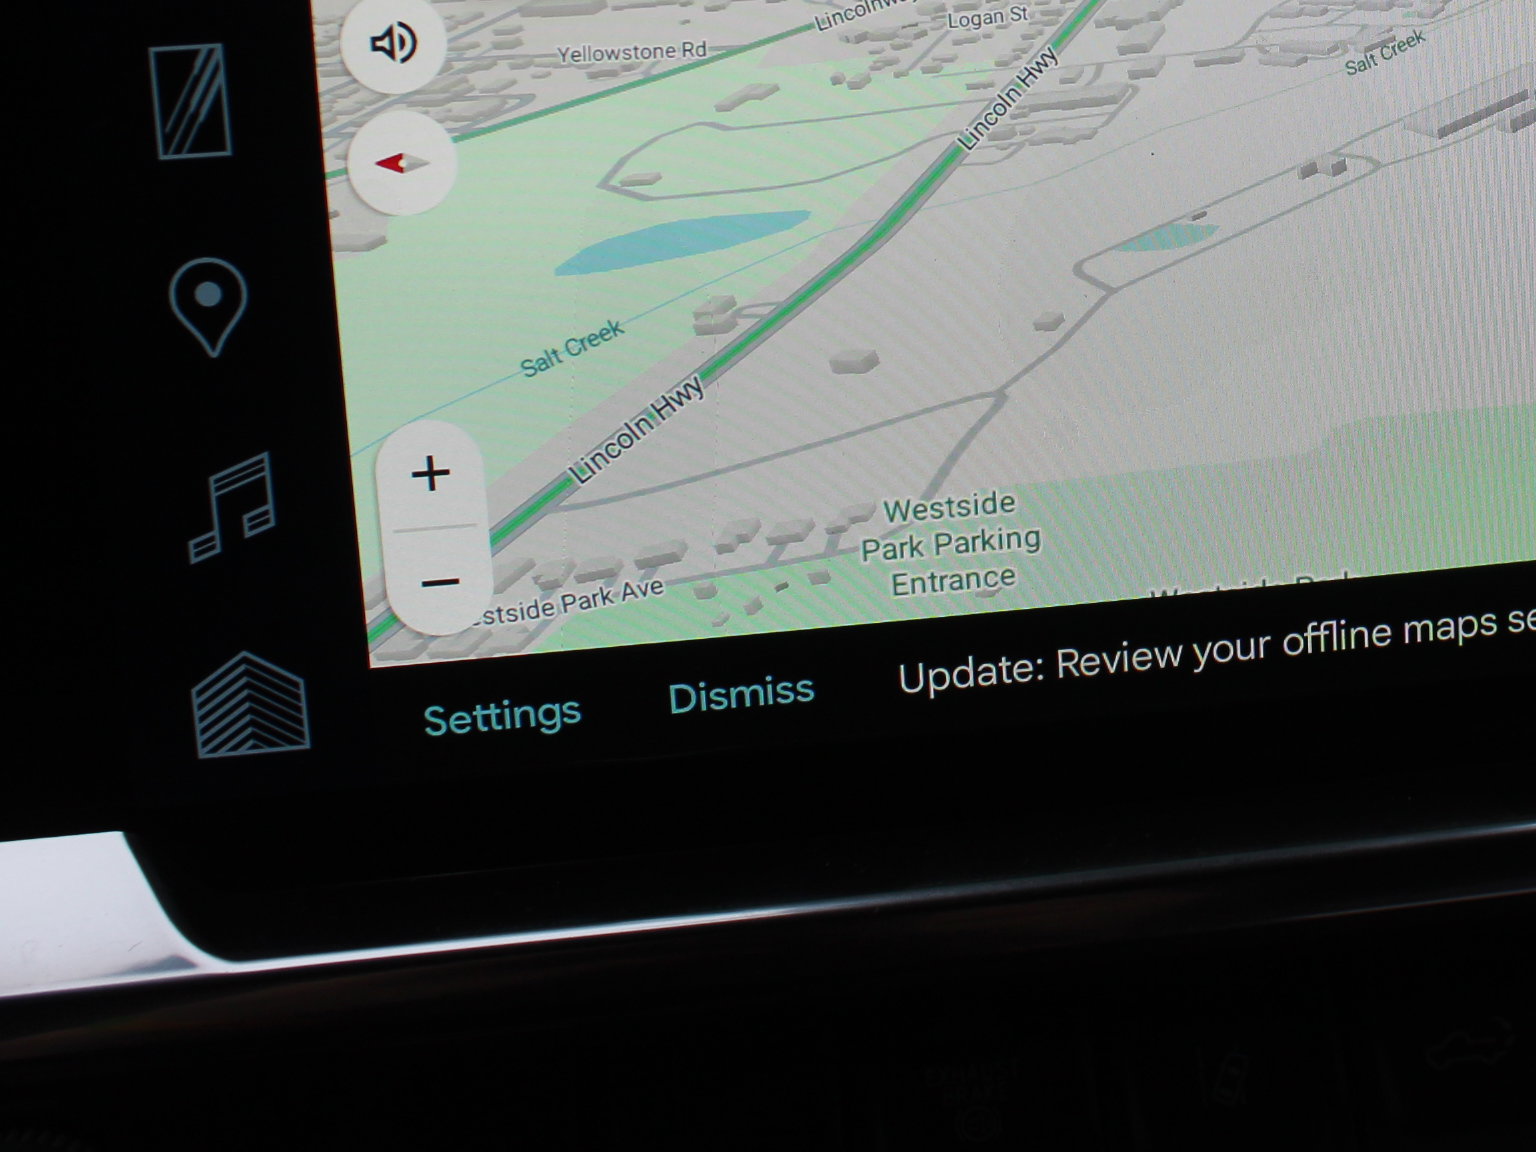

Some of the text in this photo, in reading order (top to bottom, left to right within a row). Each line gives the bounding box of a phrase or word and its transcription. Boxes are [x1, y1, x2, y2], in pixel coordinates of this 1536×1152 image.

[948, 6, 1029, 31] Logan St
[557, 41, 707, 64] Yellowstone Rd
[1345, 29, 1427, 77] Salt Creek
[957, 47, 1060, 151] Lincoln Hwy
[520, 319, 626, 378] Salt Creek
[569, 375, 705, 485] Lincoln Hwy
[883, 491, 1016, 523] Westside
[861, 527, 1041, 562] Park Parking
[472, 580, 664, 626] stside Park Ave
[892, 566, 1016, 596] Entrance
[899, 654, 1044, 700] Update:
[1057, 640, 1184, 679] Review
[1192, 632, 1272, 673] your
[1282, 619, 1393, 656] offline
[1404, 614, 1497, 646] maps
[424, 675, 815, 738] Settings Dismiss
